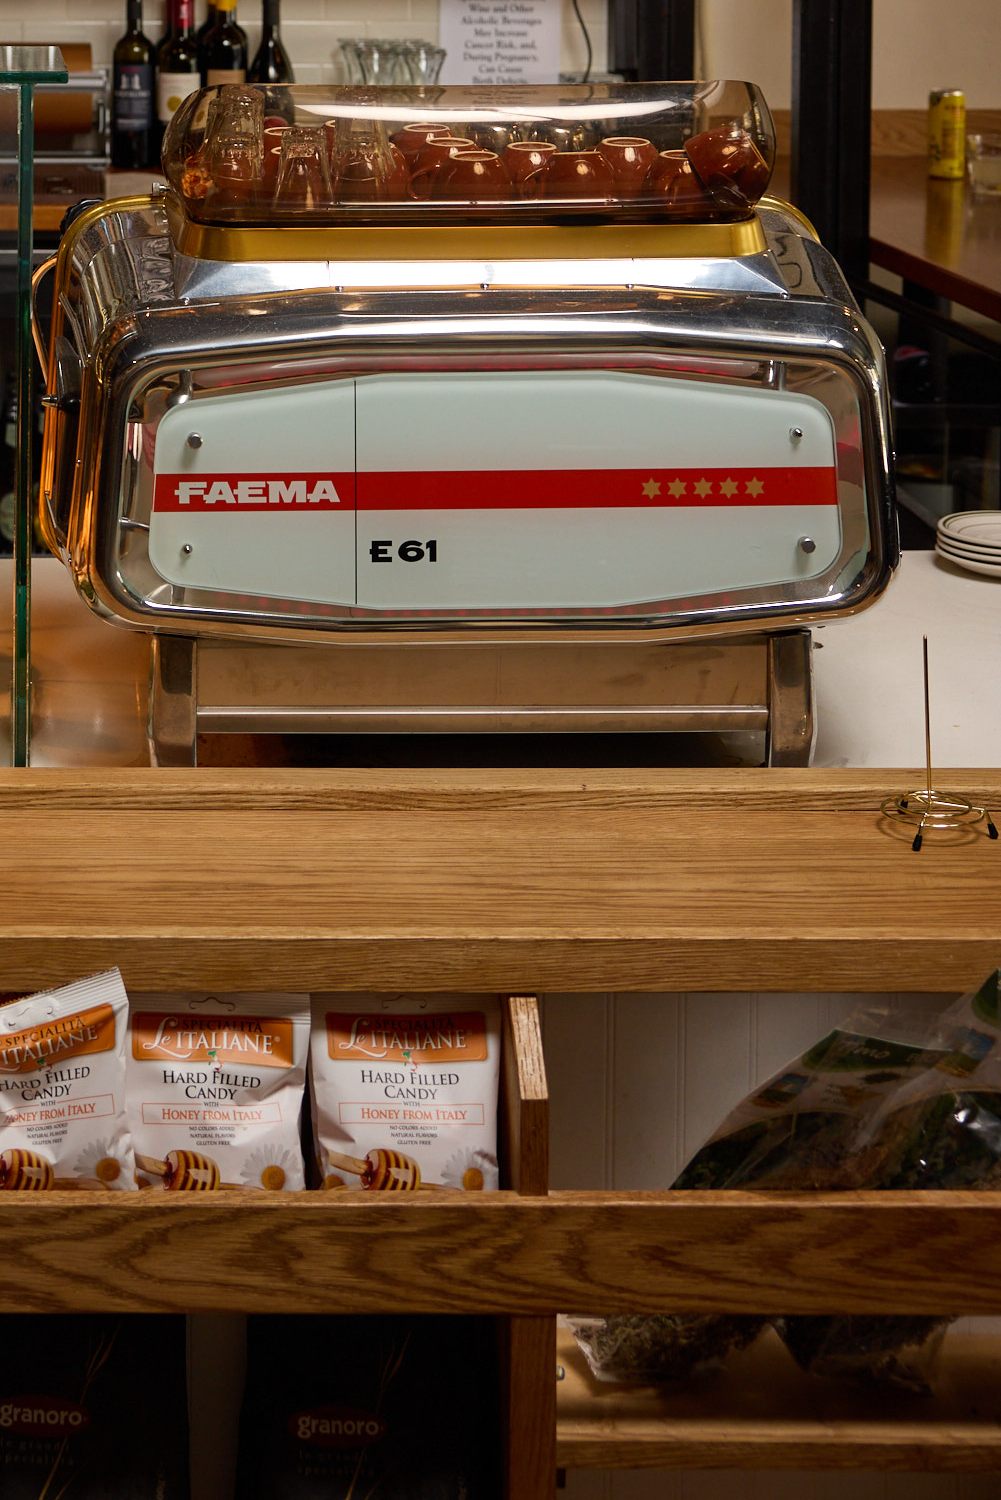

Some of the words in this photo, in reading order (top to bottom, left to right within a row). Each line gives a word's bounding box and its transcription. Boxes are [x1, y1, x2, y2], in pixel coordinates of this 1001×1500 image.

[175, 480, 340, 504] FAEMA
[143, 1016, 192, 1058] Le
[177, 1032, 273, 1054] ITALIANE
[372, 1030, 466, 1050] ITALIANE
[45, 1066, 90, 1084] FILLED
[163, 1070, 207, 1084] HARD
[213, 1071, 261, 1088] FILLED
[361, 1070, 405, 1084] HARD
[410, 1072, 460, 1085] FILLED
[22, 1084, 72, 1101] CANDY
[185, 1085, 237, 1100] CANDY
[384, 1085, 438, 1099] CANDY
[40, 1108, 65, 1120] FROM
[67, 1103, 96, 1116] ITALY
[162, 1108, 200, 1120] HONEY
[203, 1110, 230, 1120] FROM
[233, 1108, 262, 1120] ITALY
[361, 1108, 399, 1119] HONEY
[402, 1109, 432, 1119] FROM
[436, 1109, 467, 1120] ITALY
[0, 1404, 82, 1428] granoro
[298, 1415, 380, 1440] granoro
